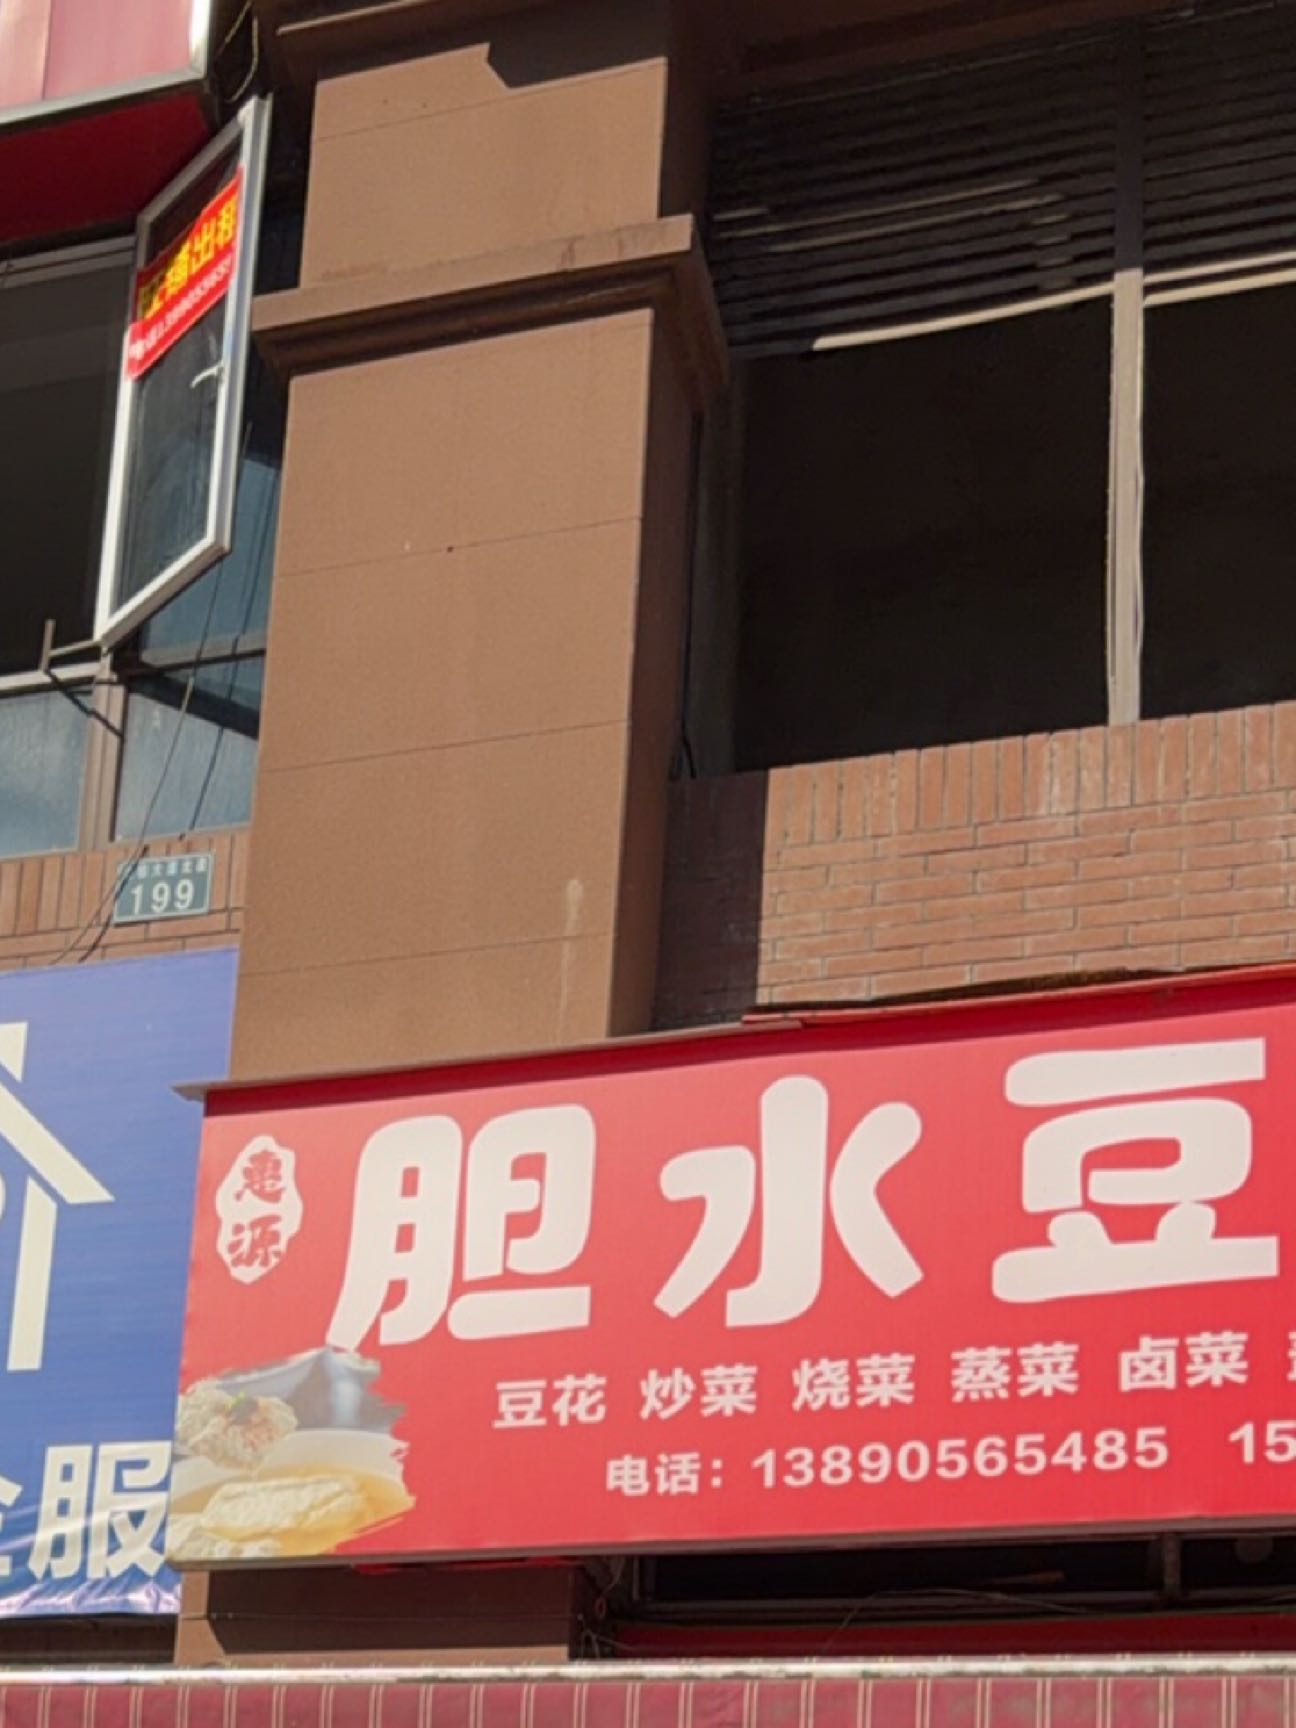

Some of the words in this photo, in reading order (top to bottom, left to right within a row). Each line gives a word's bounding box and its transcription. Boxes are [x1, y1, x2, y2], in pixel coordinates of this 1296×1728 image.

[131, 879, 195, 914] 199
[326, 1037, 1280, 1352] 胆水豆
[493, 1376, 606, 1429] 豆花
[639, 1362, 759, 1422] 炒菜
[792, 1353, 917, 1412] 烧菜
[951, 1341, 1081, 1403] 蒸菜
[1119, 1331, 1250, 1393] 卤菜
